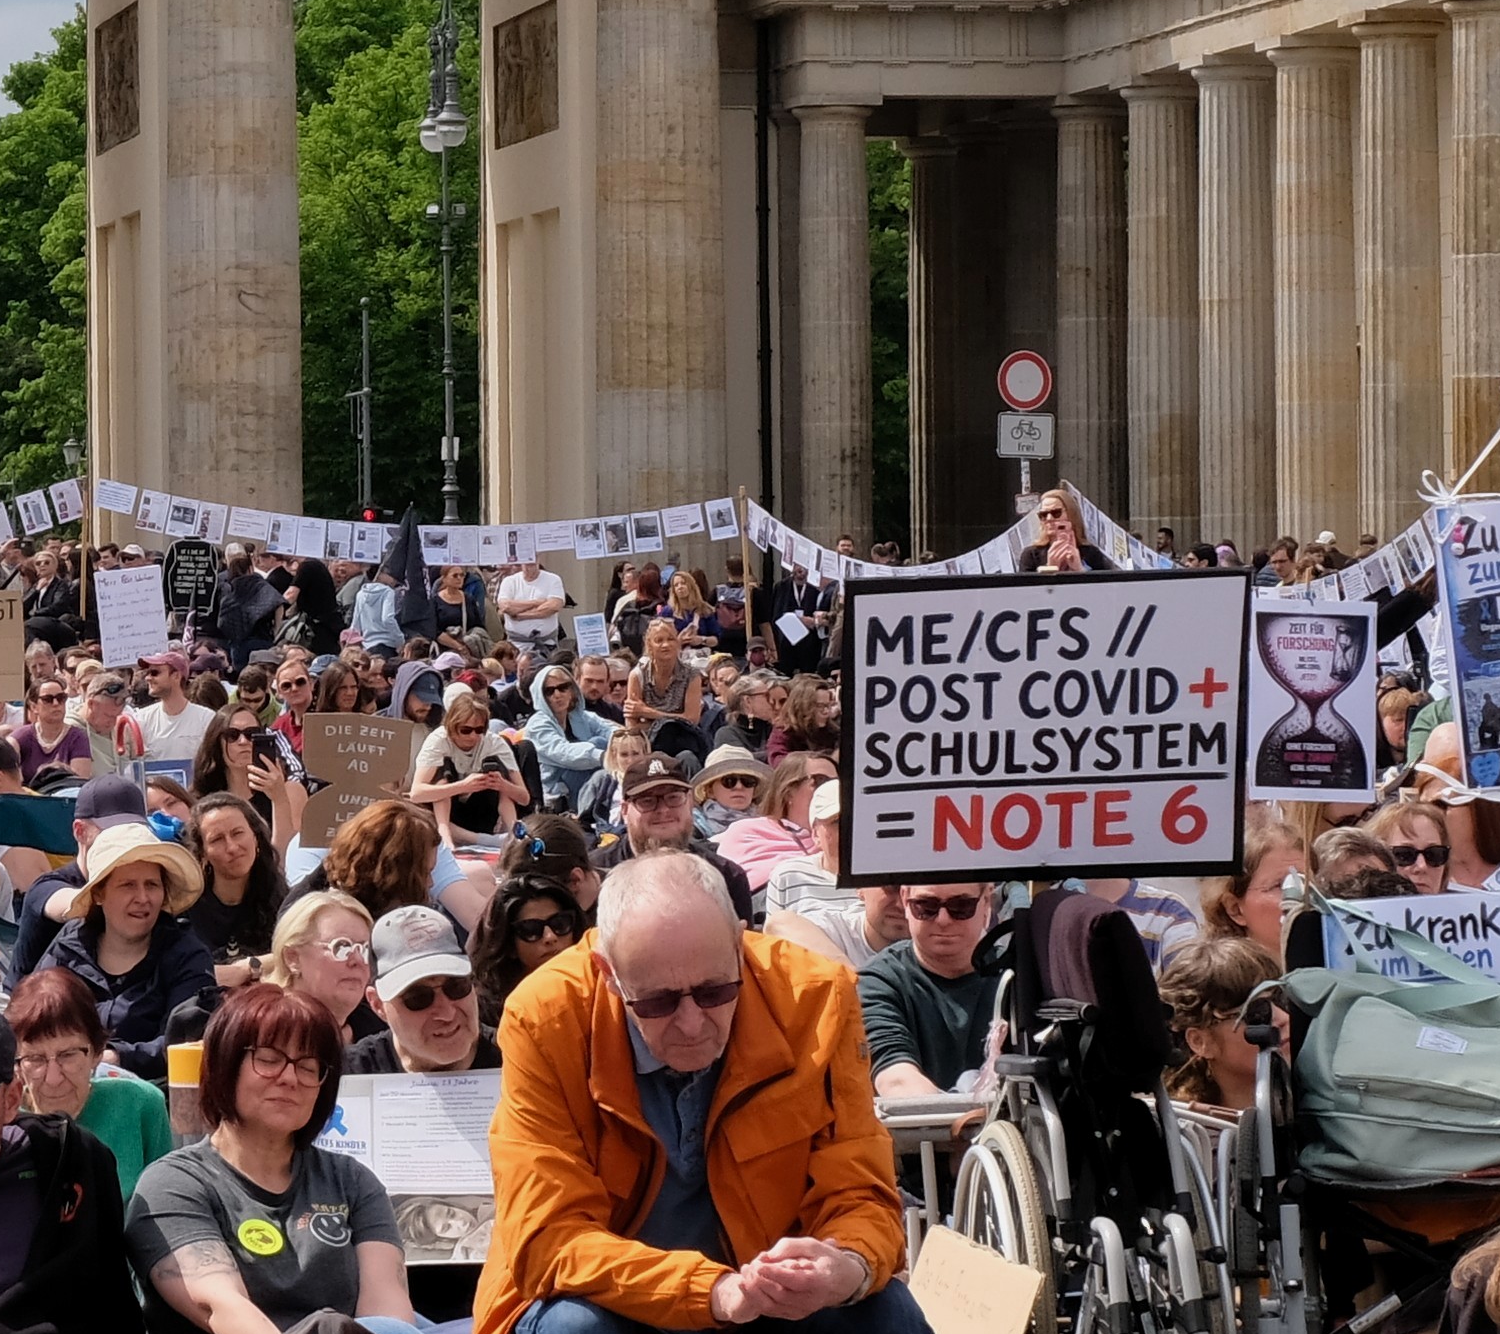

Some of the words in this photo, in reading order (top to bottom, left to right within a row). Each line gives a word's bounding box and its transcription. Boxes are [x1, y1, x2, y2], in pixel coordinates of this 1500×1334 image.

[1017, 441, 1035, 452] frei
[1454, 515, 1500, 559] Zu
[864, 606, 1091, 667] ME/CFS
[1105, 603, 1159, 659] //
[1288, 622, 1307, 635] ZEIT
[1309, 621, 1325, 636] FÜR
[1277, 636, 1337, 652] FORSCHUNG
[864, 670, 1003, 726] POST
[1017, 666, 1180, 720] COVID
[1188, 666, 1230, 709] +
[325, 725, 352, 737] DIE
[360, 725, 396, 741] ZEIT
[863, 721, 1228, 778] SCHULSYSTEM
[347, 758, 369, 773] AB
[338, 794, 377, 806] UNSE
[875, 810, 916, 839] =
[931, 789, 1135, 853] NOTE
[1160, 783, 1209, 846] 6
